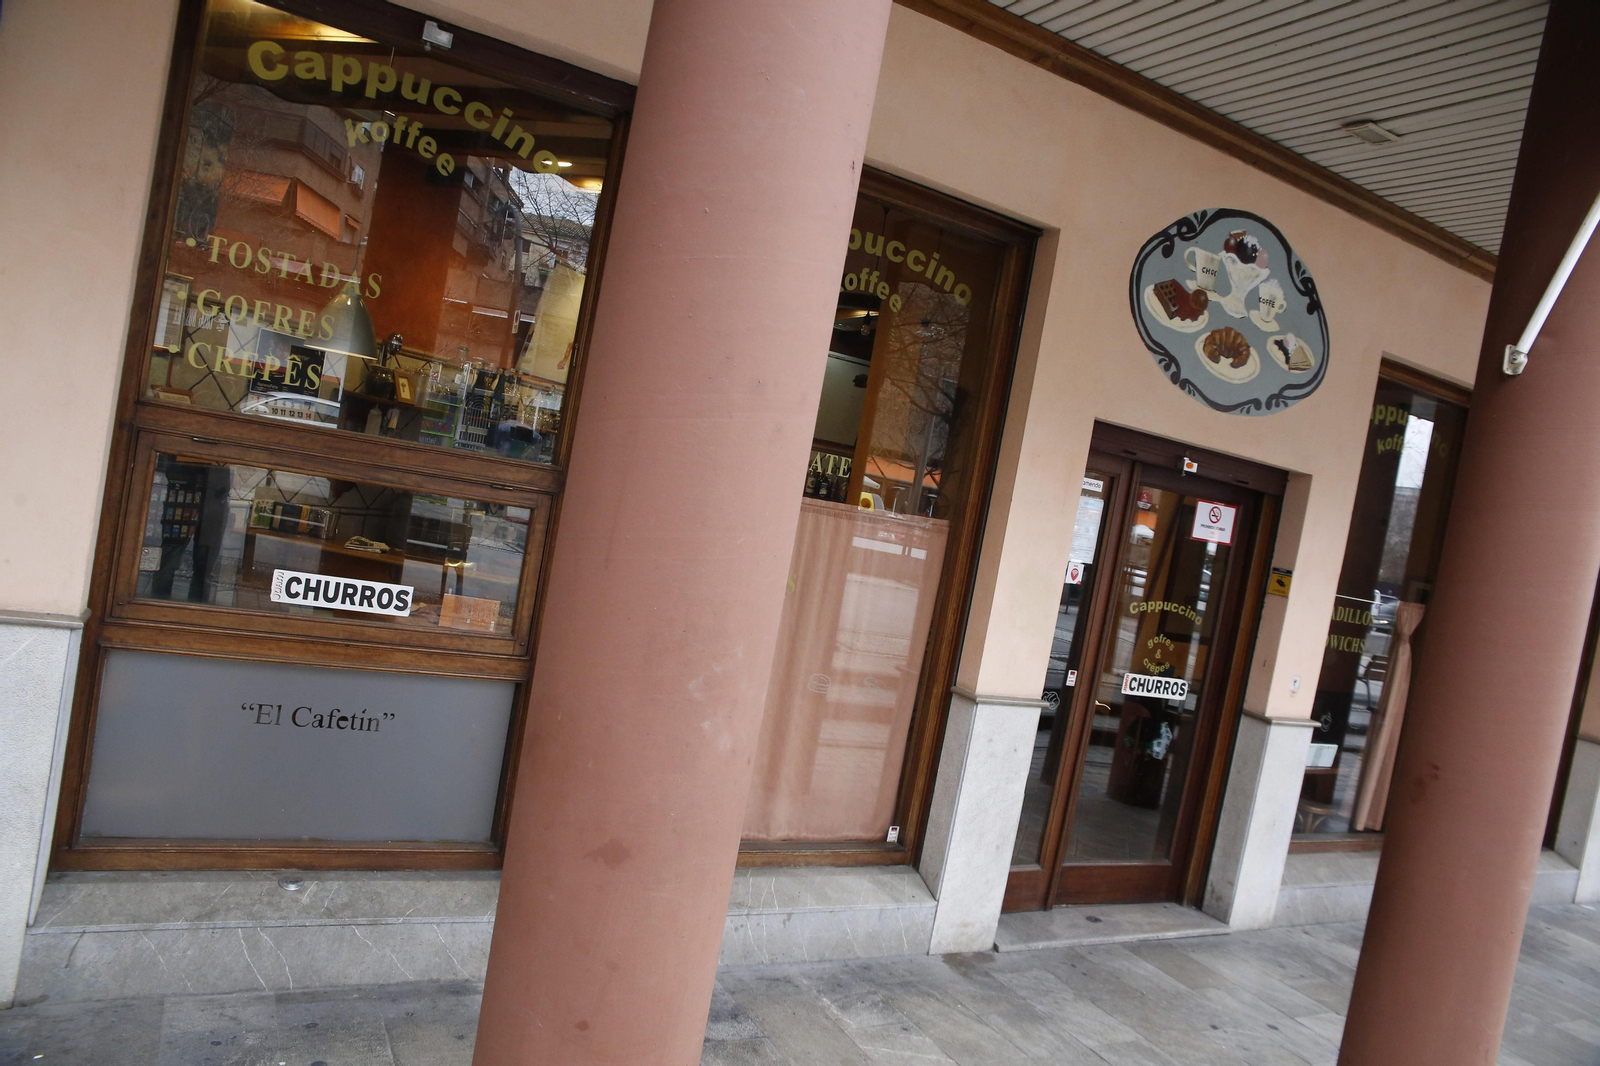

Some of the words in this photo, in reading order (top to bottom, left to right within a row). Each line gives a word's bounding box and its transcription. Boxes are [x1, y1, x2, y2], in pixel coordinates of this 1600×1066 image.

[247, 40, 561, 176] Cappuccino
[344, 116, 455, 177] koffee
[206, 235, 383, 300] TOSTADAS
[840, 267, 903, 313] offee
[196, 289, 335, 341] GOFRES
[187, 342, 322, 391] CREPÊS
[271, 407, 279, 415] 10
[289, 410, 296, 418] 12
[297, 411, 304, 419] 13
[284, 576, 411, 612] CHURROS
[1129, 600, 1203, 626] Cappuccino
[1147, 633, 1175, 652] gofres
[1155, 649, 1162, 659] &
[1129, 676, 1187, 697] CHURROS
